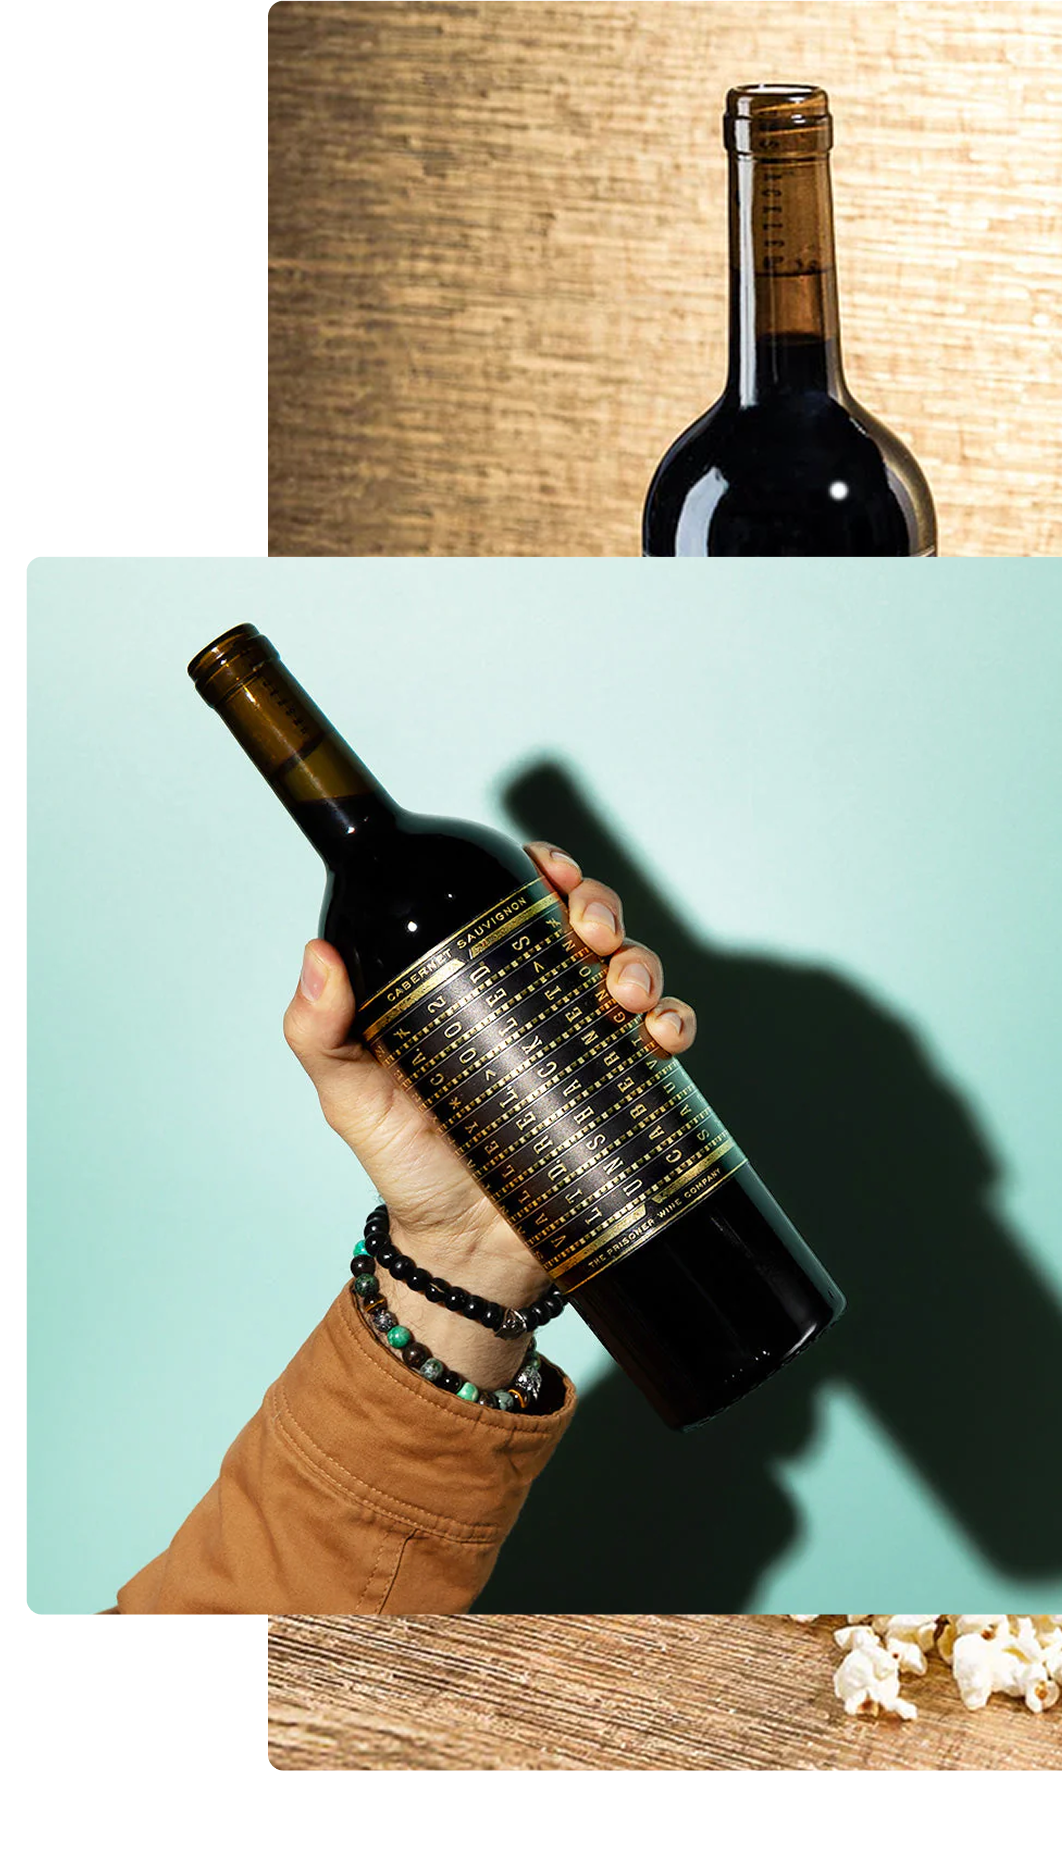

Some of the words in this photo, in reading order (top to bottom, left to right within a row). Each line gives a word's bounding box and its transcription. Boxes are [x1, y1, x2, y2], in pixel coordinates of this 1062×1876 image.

[386, 949, 452, 1002] CABERNET
[456, 897, 527, 949] SAUVIGNON
[587, 1253, 607, 1269] THE
[607, 1218, 655, 1256] PRISONER
[657, 1198, 683, 1219] WINE
[684, 1167, 722, 1199] COMPANY
